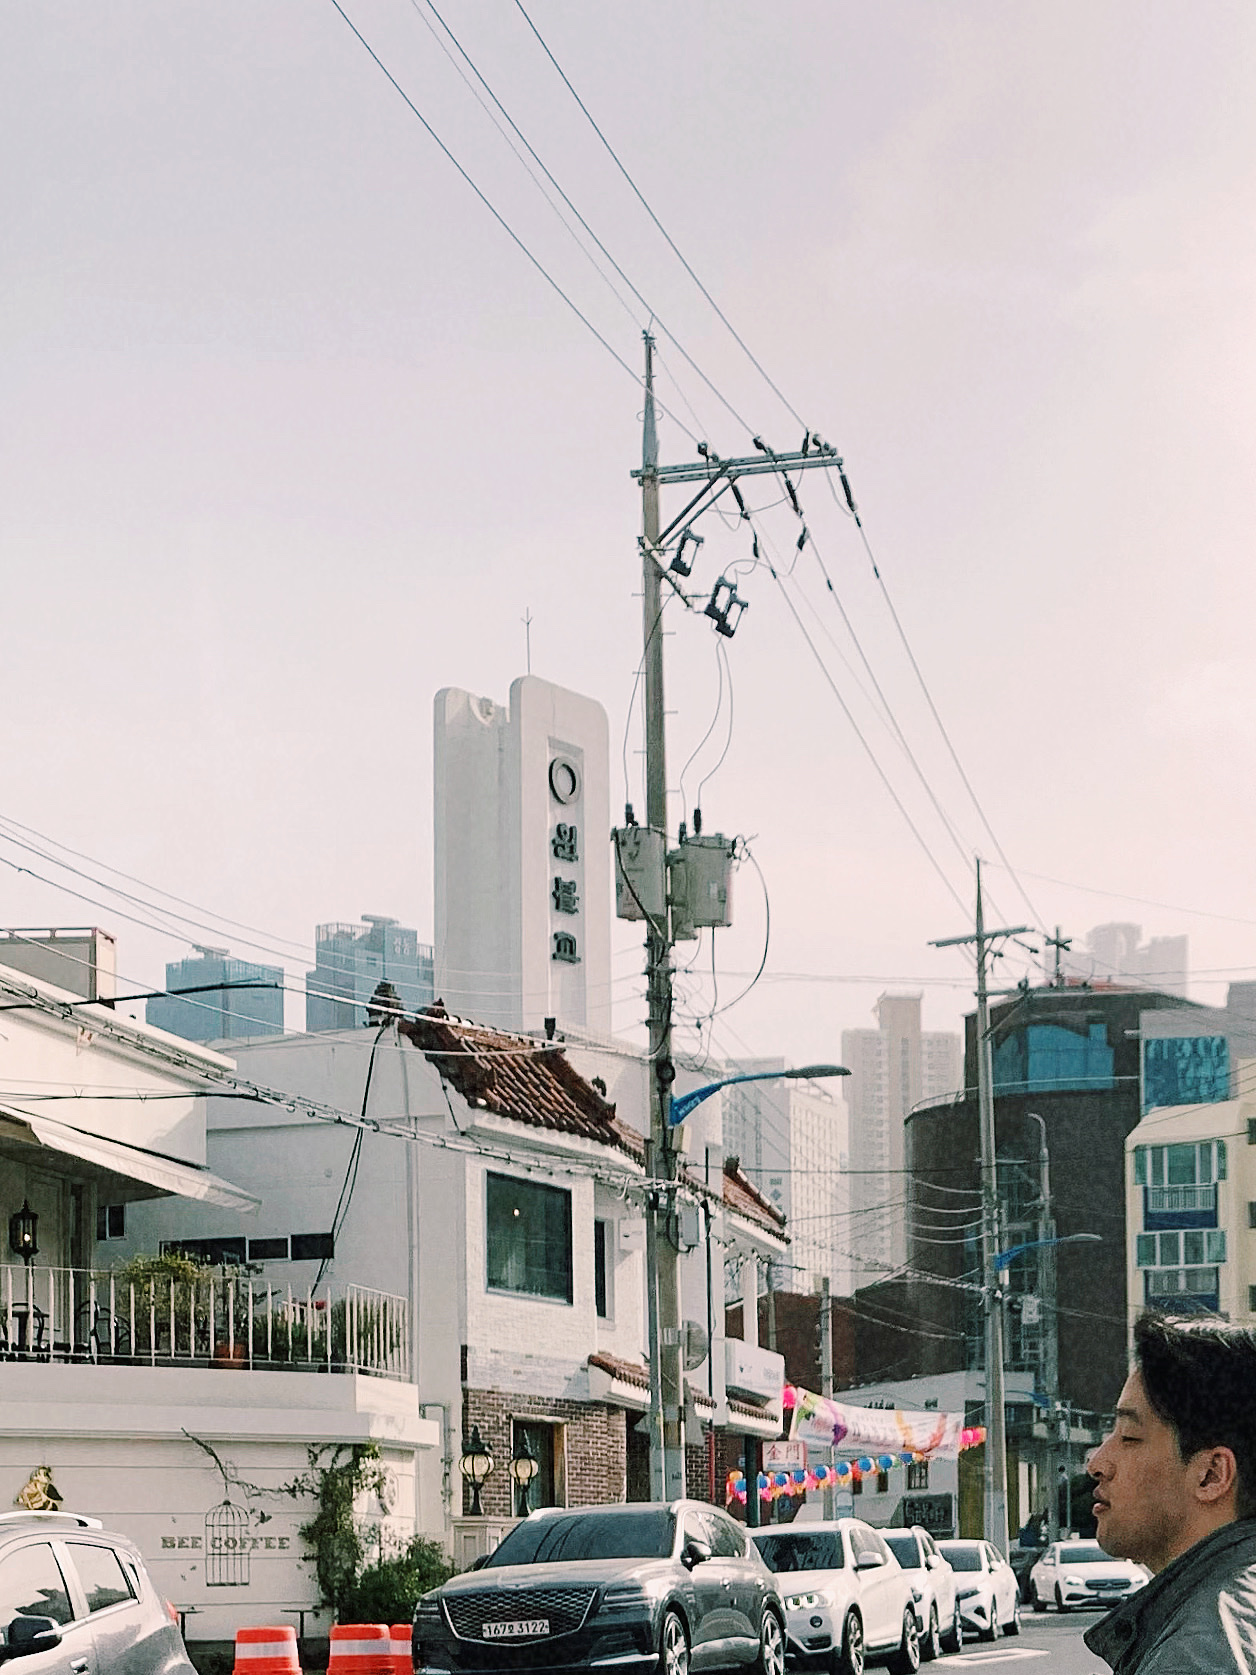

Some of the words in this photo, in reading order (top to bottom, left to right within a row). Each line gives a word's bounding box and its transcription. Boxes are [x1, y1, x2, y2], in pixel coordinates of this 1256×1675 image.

[551, 822, 581, 966] 원불교
[766, 1444, 800, 1460] 金門
[161, 1537, 202, 1549] BEE
[211, 1537, 290, 1549] COFFEE
